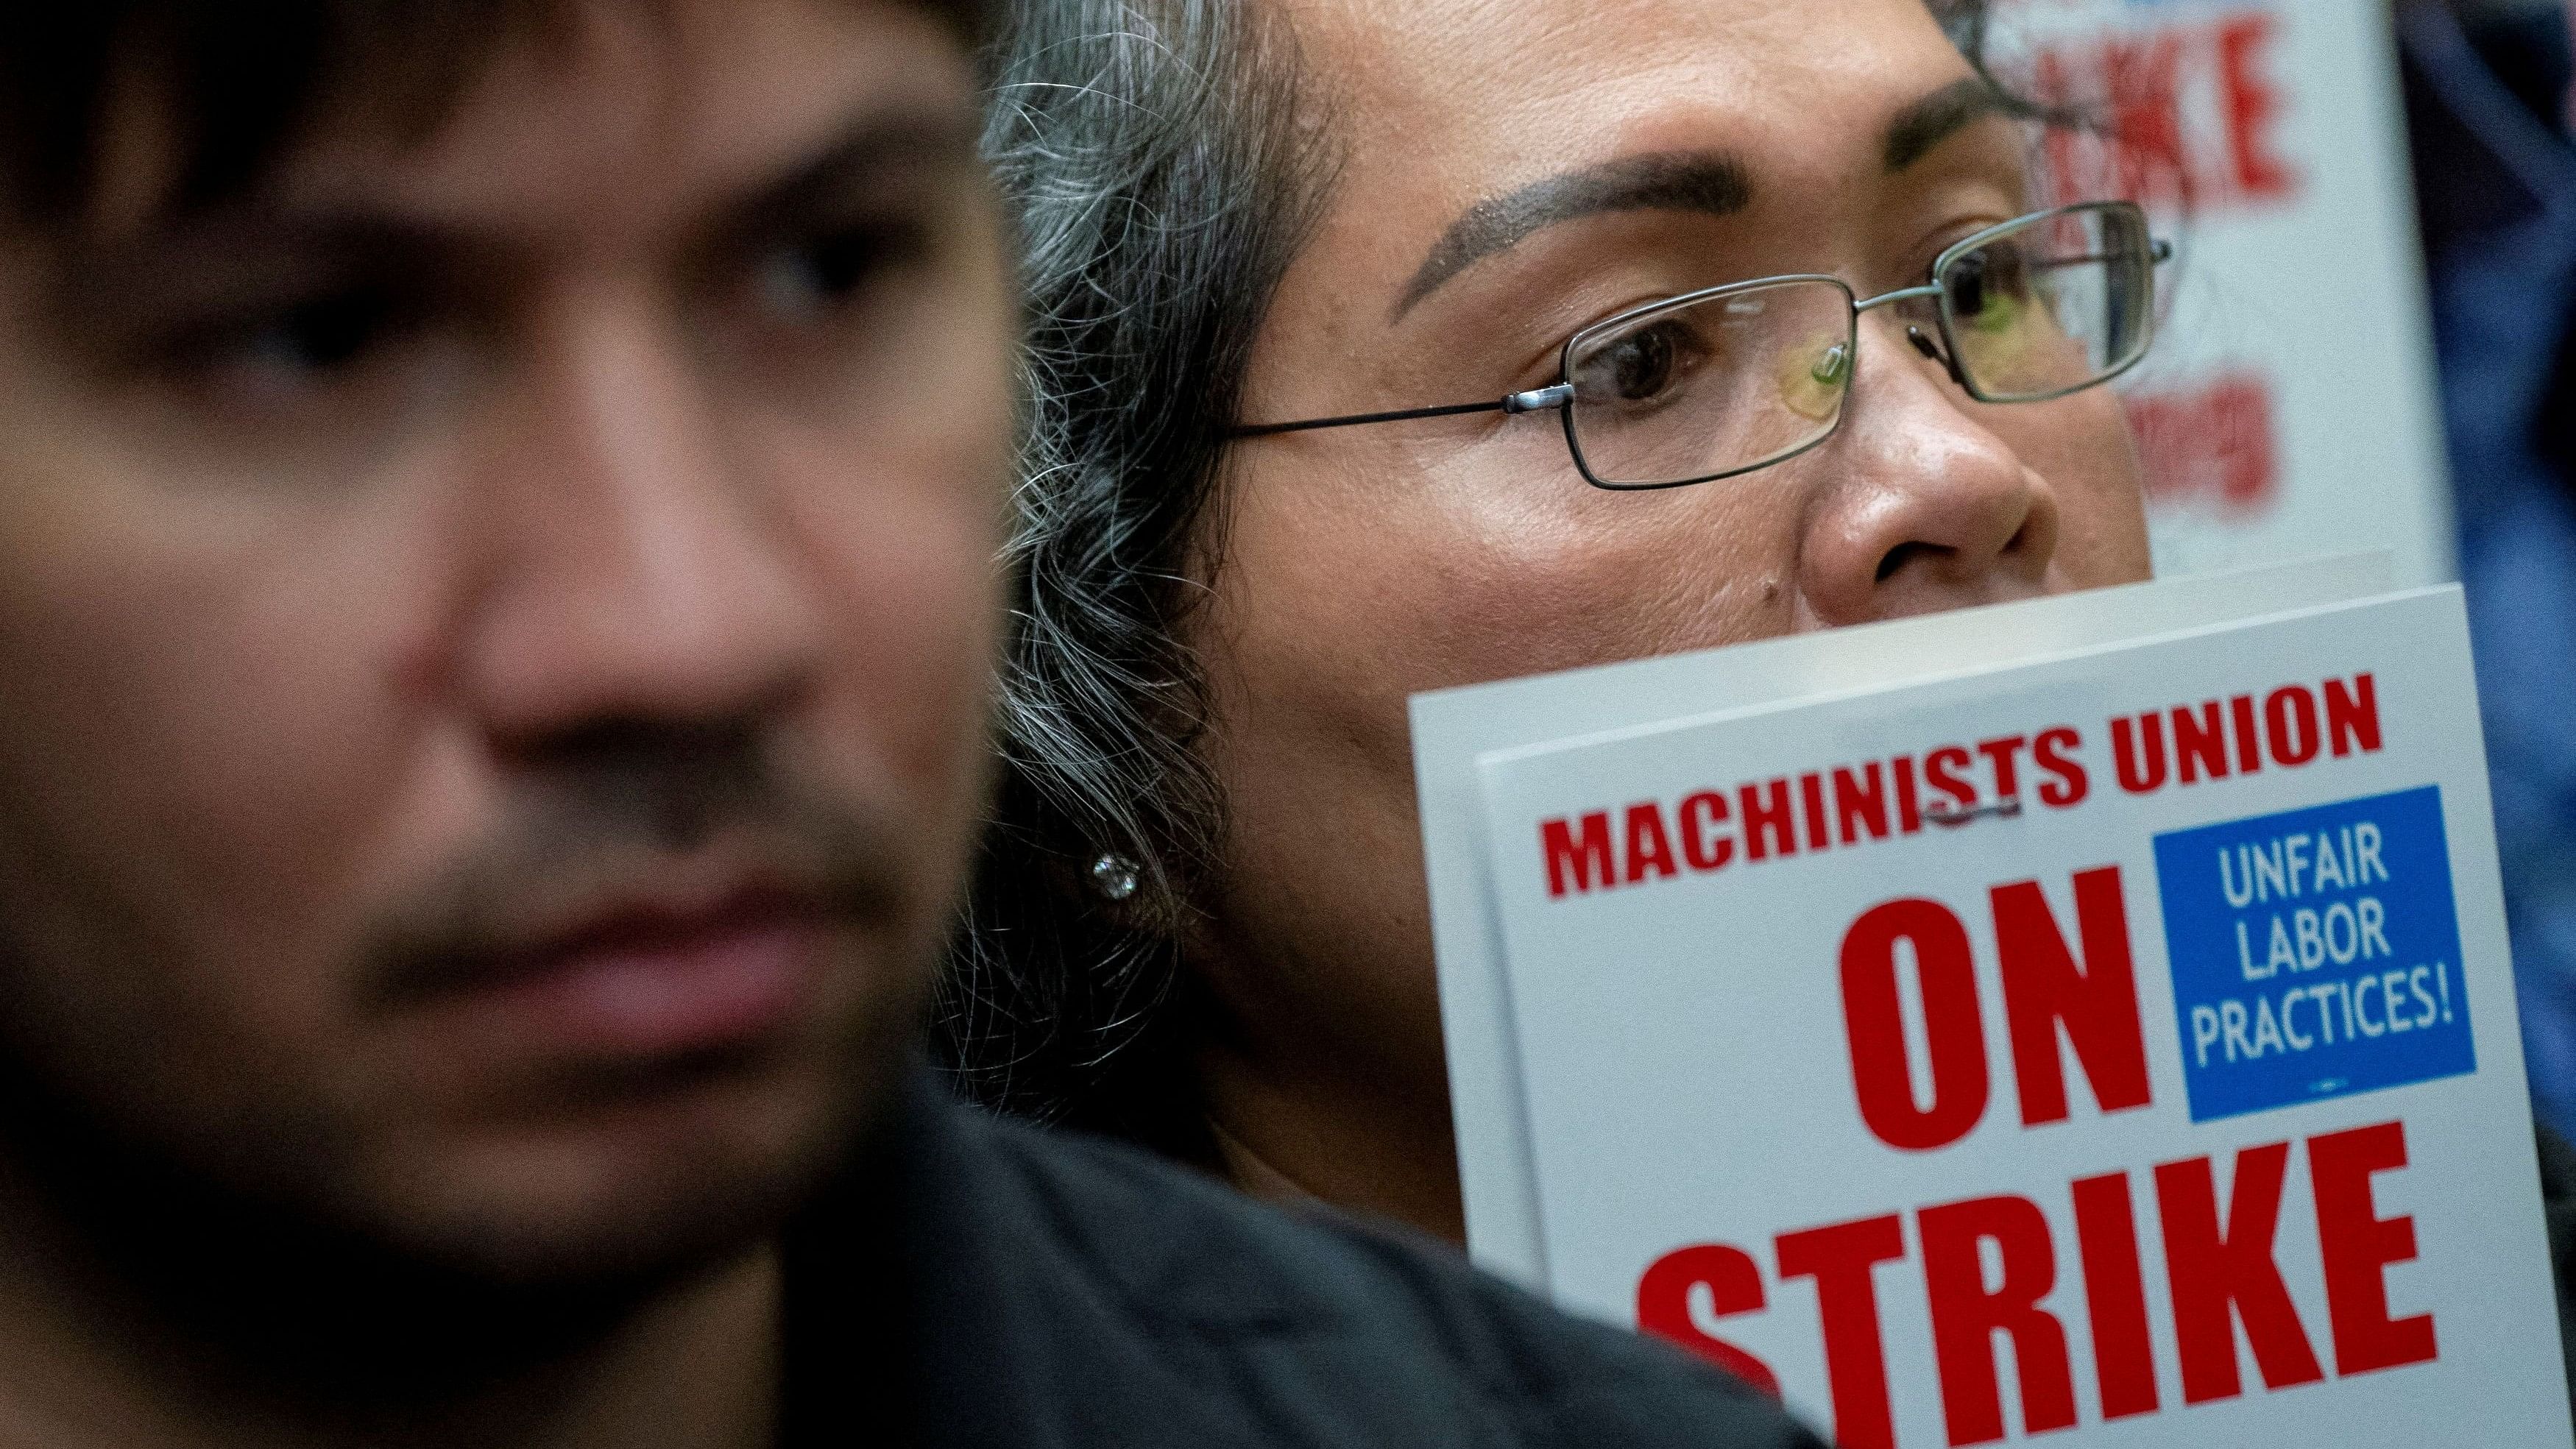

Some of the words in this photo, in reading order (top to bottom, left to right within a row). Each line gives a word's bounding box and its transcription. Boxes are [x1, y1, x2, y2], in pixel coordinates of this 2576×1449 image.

[1540, 725, 2089, 897] MACHINISTS
[2109, 673, 2382, 795] UNION
[2218, 821, 2389, 908] UNFAIR
[2236, 897, 2392, 981] LABOR
[1839, 865, 2152, 1152] ON
[2191, 960, 2453, 1068] PRACTICES!
